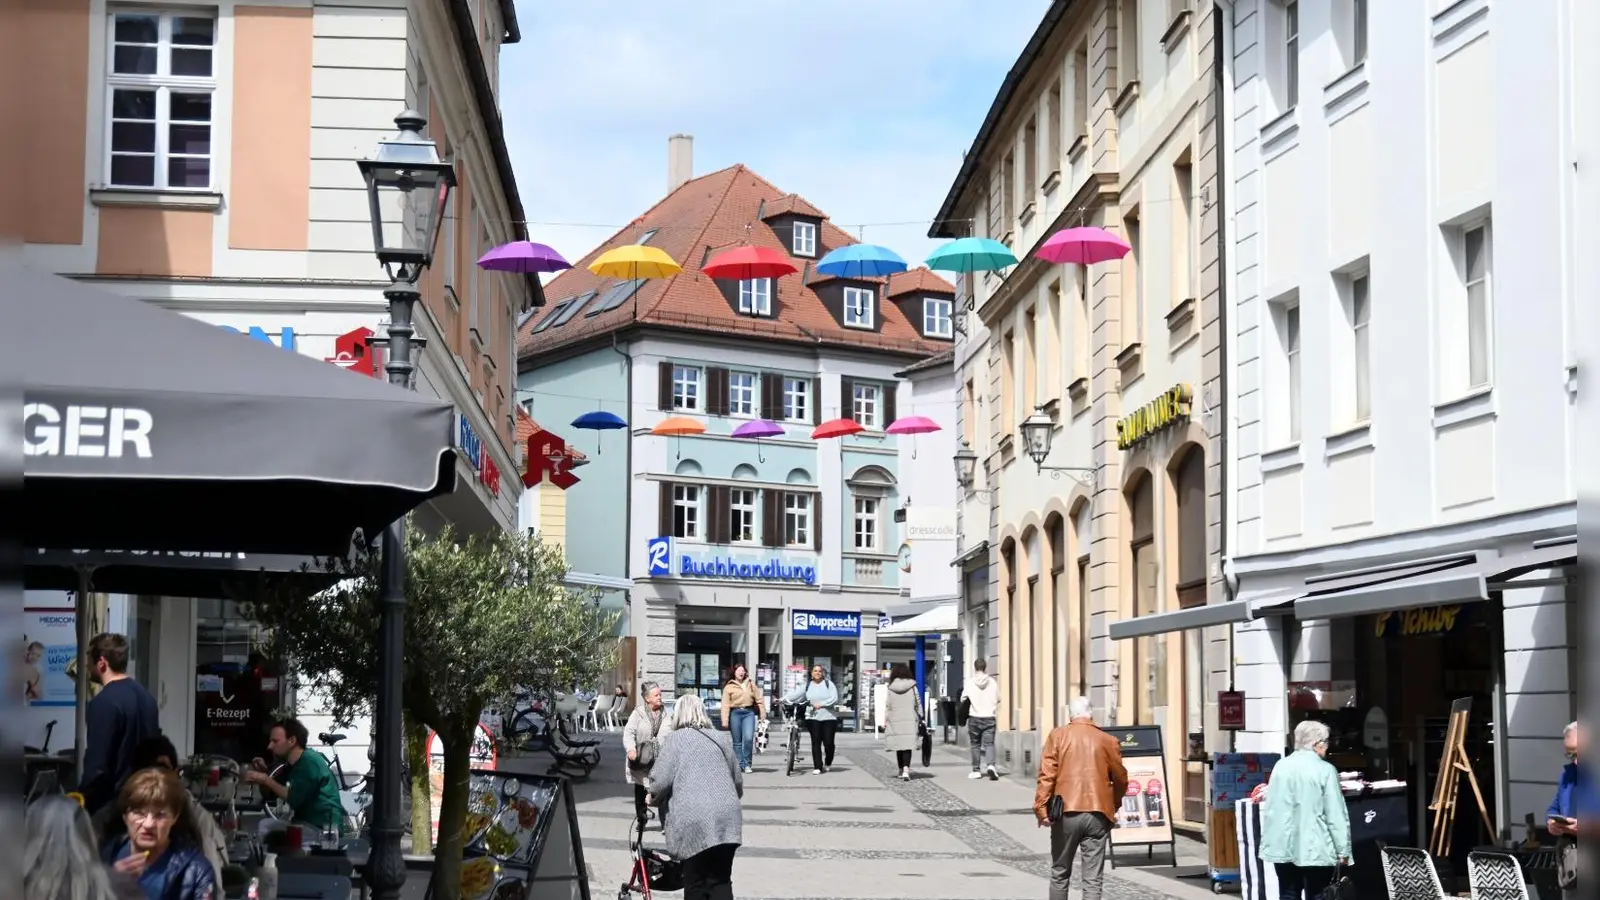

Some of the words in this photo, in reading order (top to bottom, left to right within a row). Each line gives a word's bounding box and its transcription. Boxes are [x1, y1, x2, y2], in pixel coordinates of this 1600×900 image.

[24, 402, 153, 458] GER
[909, 525, 955, 535] dresscode
[680, 554, 816, 585] Buchhandlung
[808, 614, 858, 631] Rupprecht
[207, 708, 250, 720] E-Rezept
